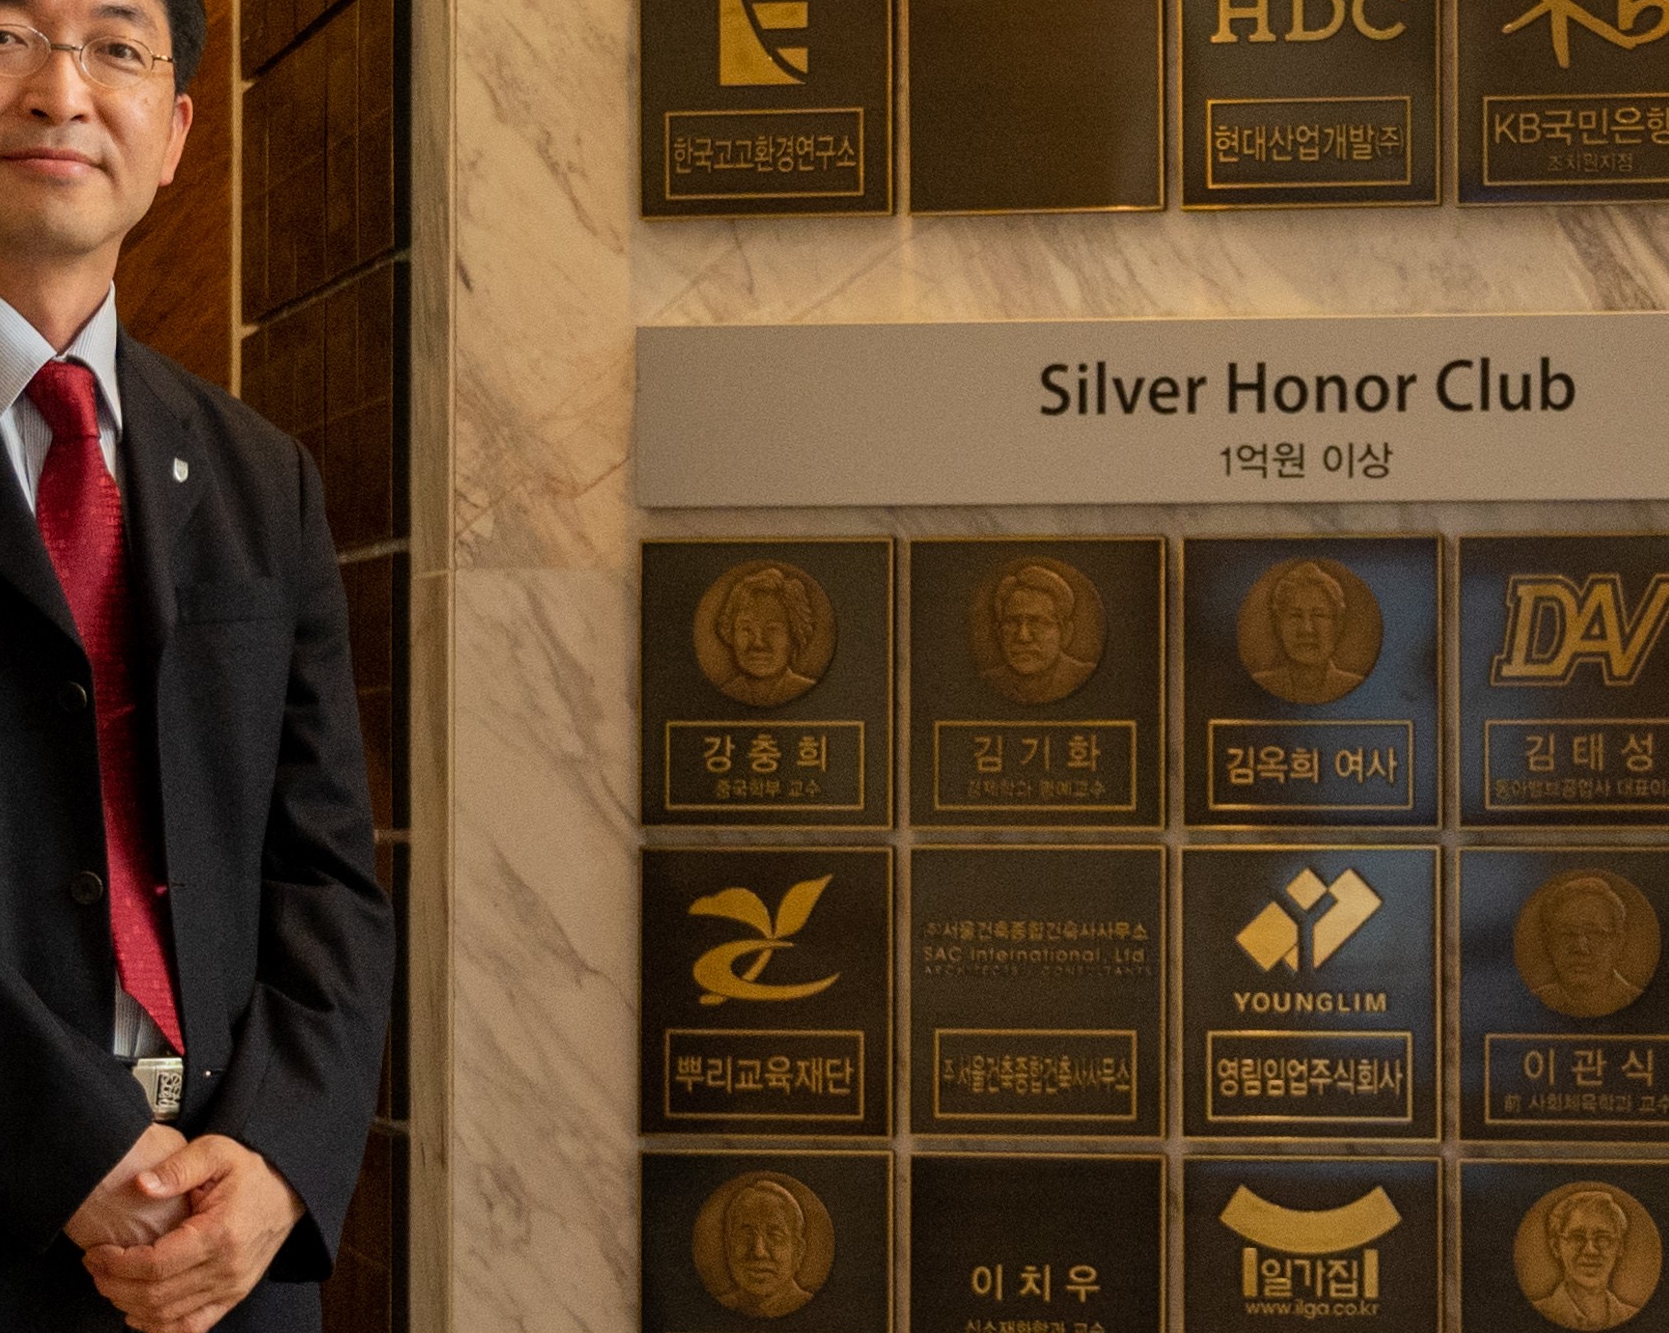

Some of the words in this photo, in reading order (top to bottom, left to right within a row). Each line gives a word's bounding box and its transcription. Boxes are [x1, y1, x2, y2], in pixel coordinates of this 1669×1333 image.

[673, 135, 857, 175] 한국고고환경연구소
[1039, 361, 1207, 416] Silver
[1228, 361, 1417, 415] Honor
[1435, 356, 1576, 413] Club
[1220, 442, 1305, 479] 1억원
[1322, 441, 1393, 479] 이상
[1227, 746, 1320, 785] 김옥희
[1335, 746, 1397, 783] 여사
[789, 779, 821, 798] 교수
[1233, 992, 1387, 1013] YOUNGLIM
[676, 1056, 854, 1095] 뿌리교육재단
[1217, 1057, 1403, 1097] 영림임업주식회사
[1261, 1258, 1358, 1299] 일가집
[1244, 1301, 1380, 1319] www.ilga.co.kr
